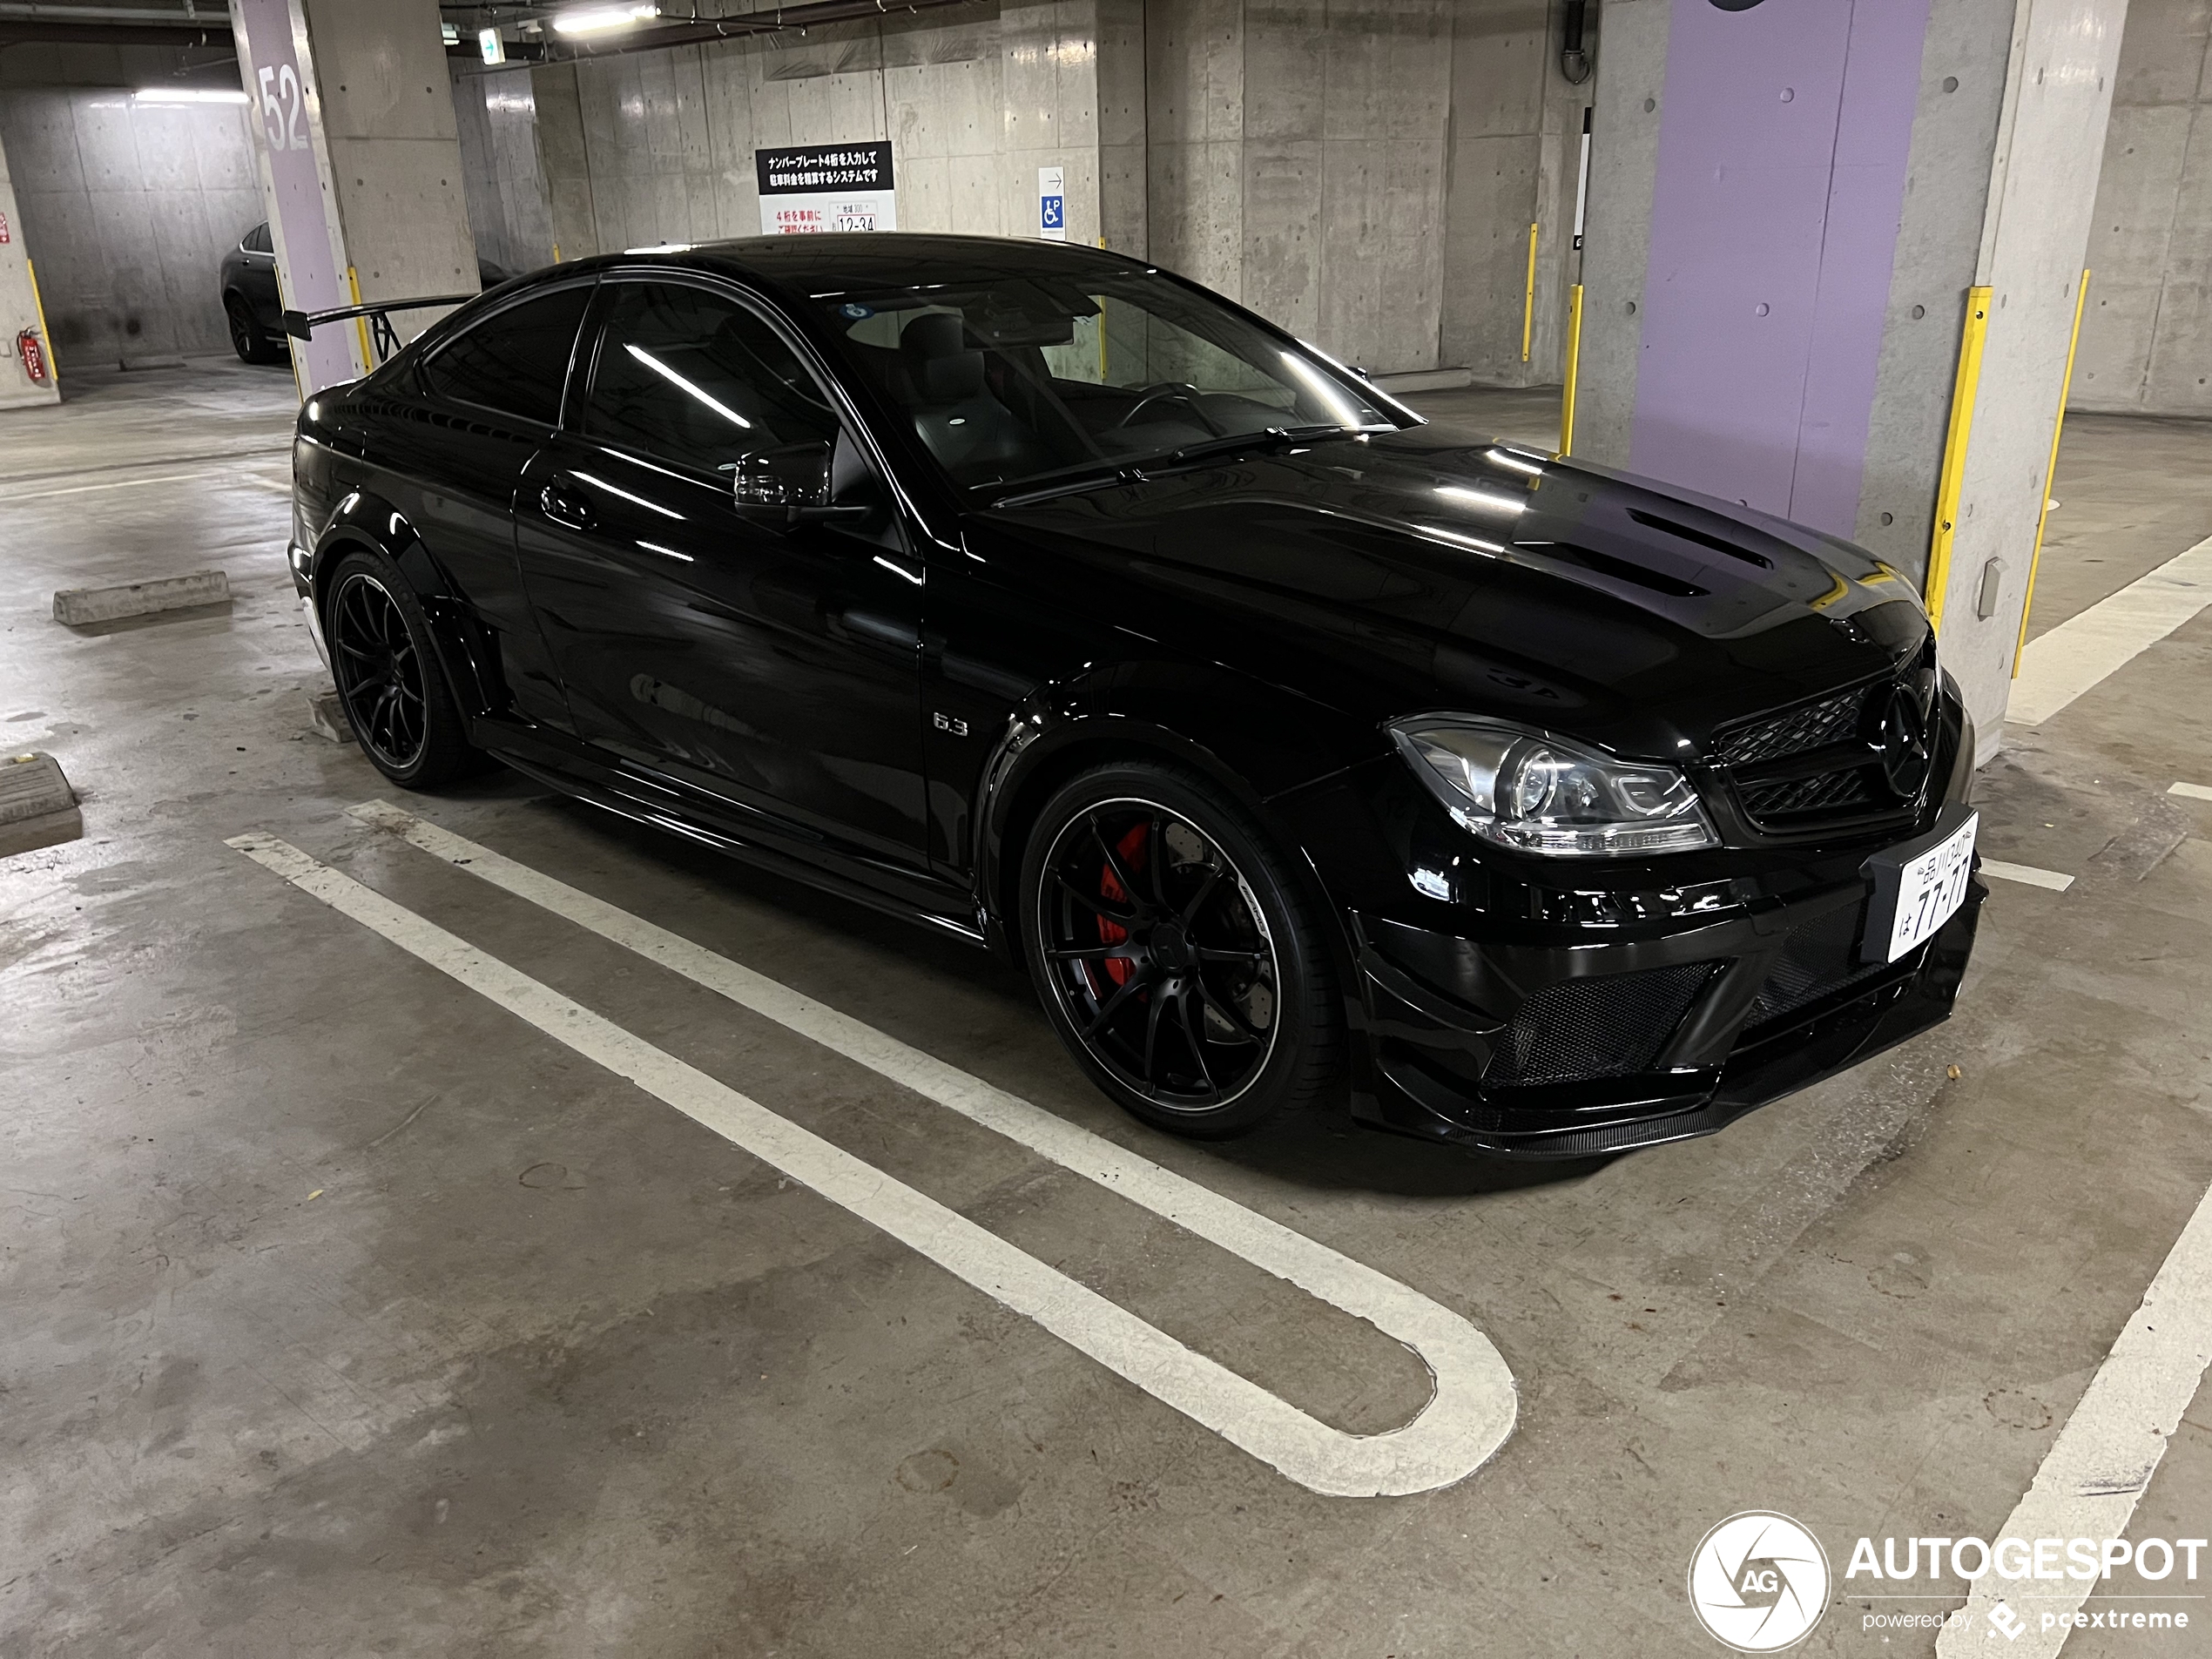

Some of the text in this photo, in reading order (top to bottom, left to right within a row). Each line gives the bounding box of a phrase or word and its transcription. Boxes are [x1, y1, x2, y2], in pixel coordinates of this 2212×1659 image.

[258, 64, 308, 152] 52
[768, 151, 877, 170] ナンバープレート4桁を入力して
[1053, 199, 1061, 211] P
[934, 711, 968, 737] 6.3
[1923, 846, 1950, 885] 品川
[1898, 912, 1912, 939] は
